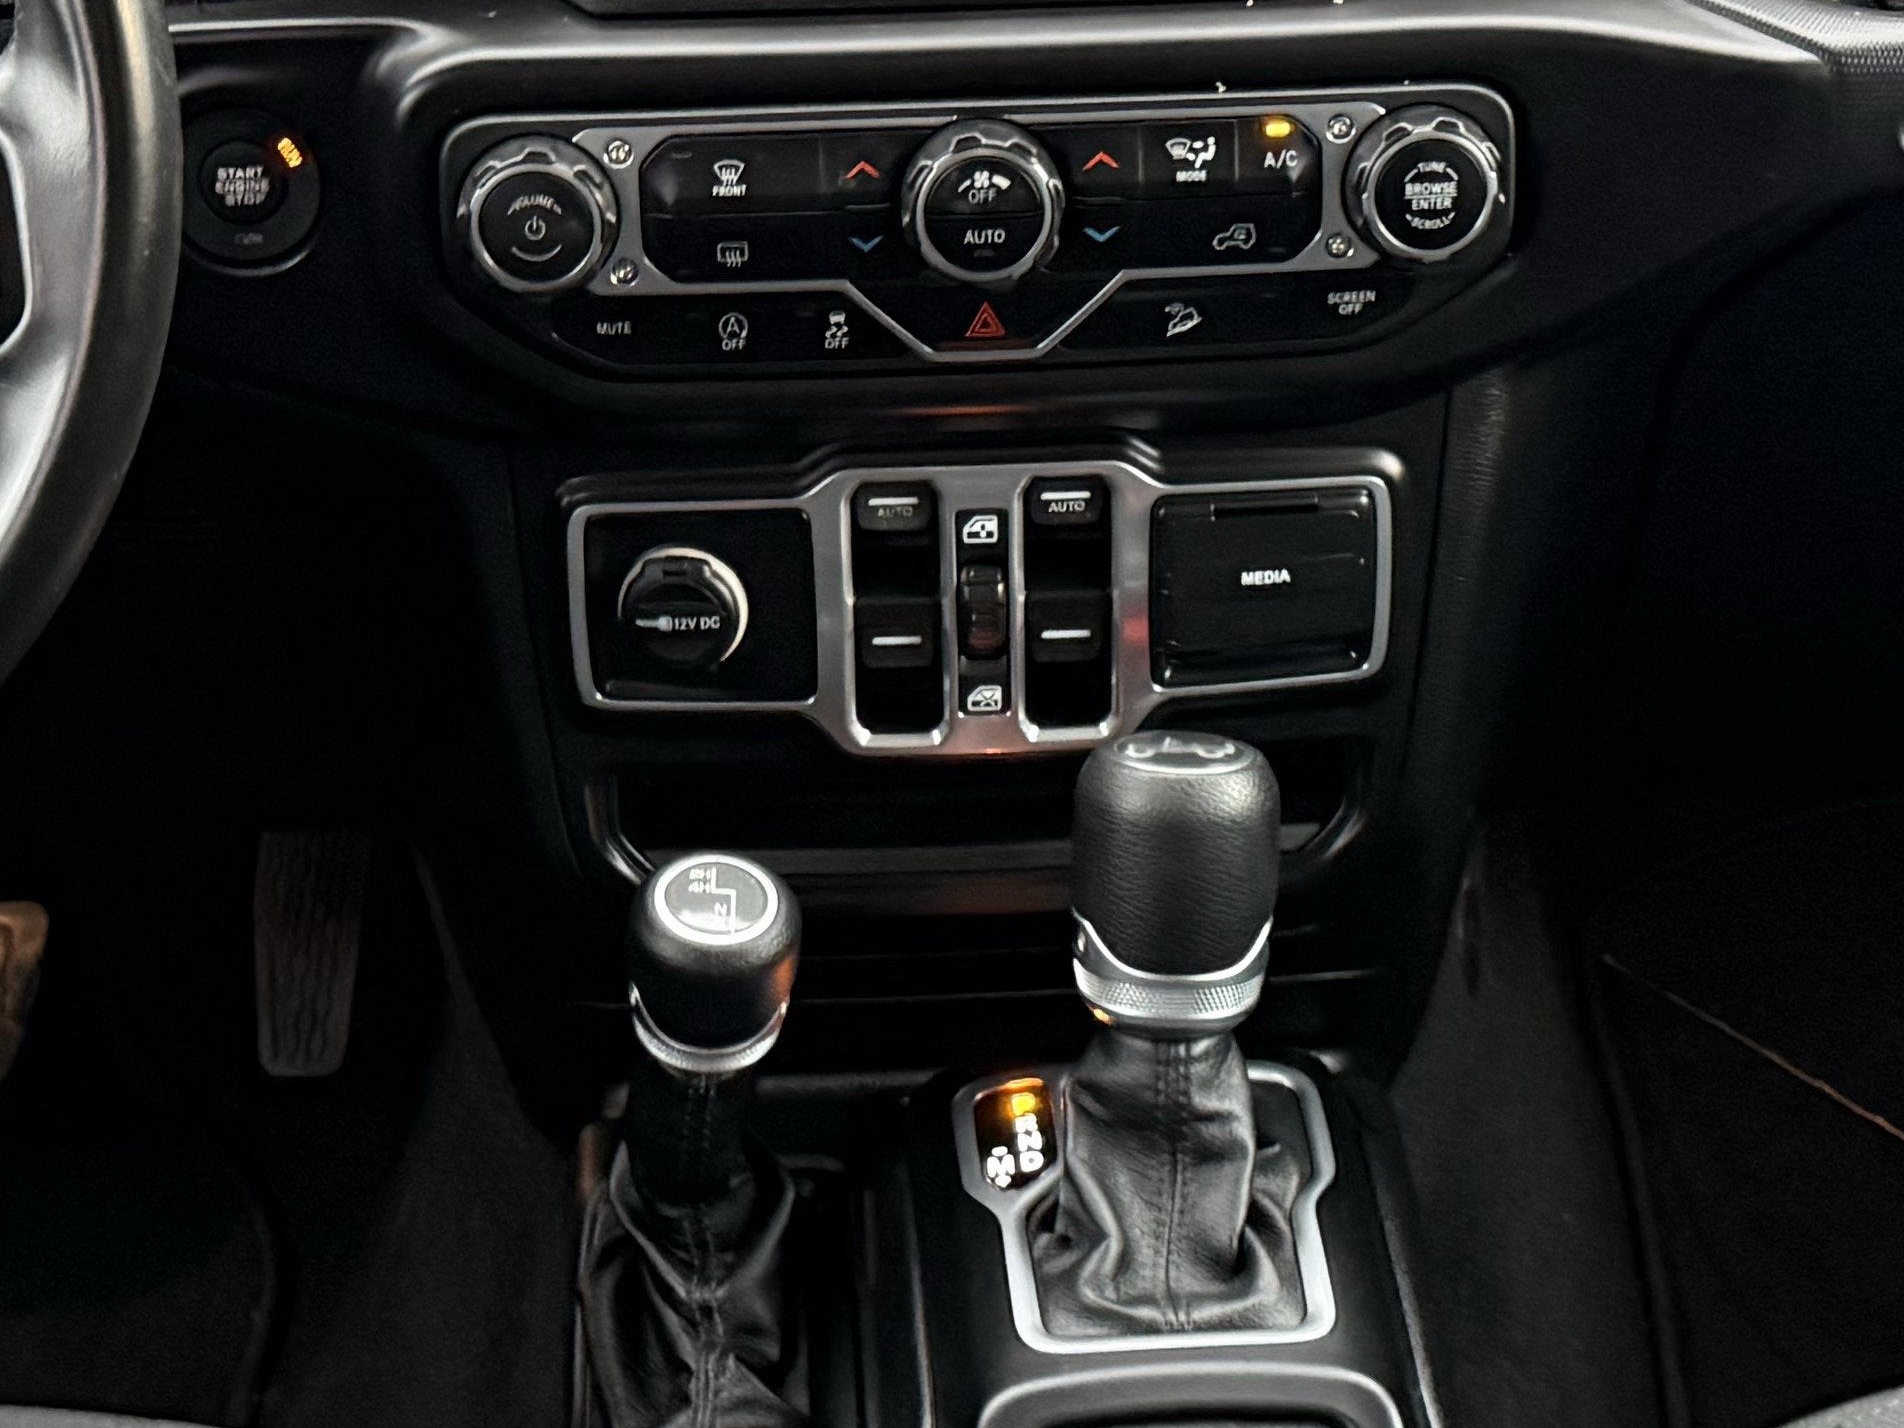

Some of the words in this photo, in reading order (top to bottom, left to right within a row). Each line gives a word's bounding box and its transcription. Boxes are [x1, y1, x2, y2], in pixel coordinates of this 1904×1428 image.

[1264, 149, 1298, 168] A/C
[968, 188, 997, 203] OFF
[1405, 182, 1457, 195] BROWSE
[1411, 198, 1452, 210] ENTER
[964, 228, 1005, 245] AUTO
[1338, 303, 1362, 316] OFF
[722, 337, 747, 350] OFF
[824, 336, 849, 350] OFF
[877, 506, 913, 518] AUTO
[1048, 501, 1086, 513] AUTO
[1241, 568, 1290, 586] MEDIA
[673, 616, 696, 631] 12V
[1020, 1150, 1044, 1172] D
